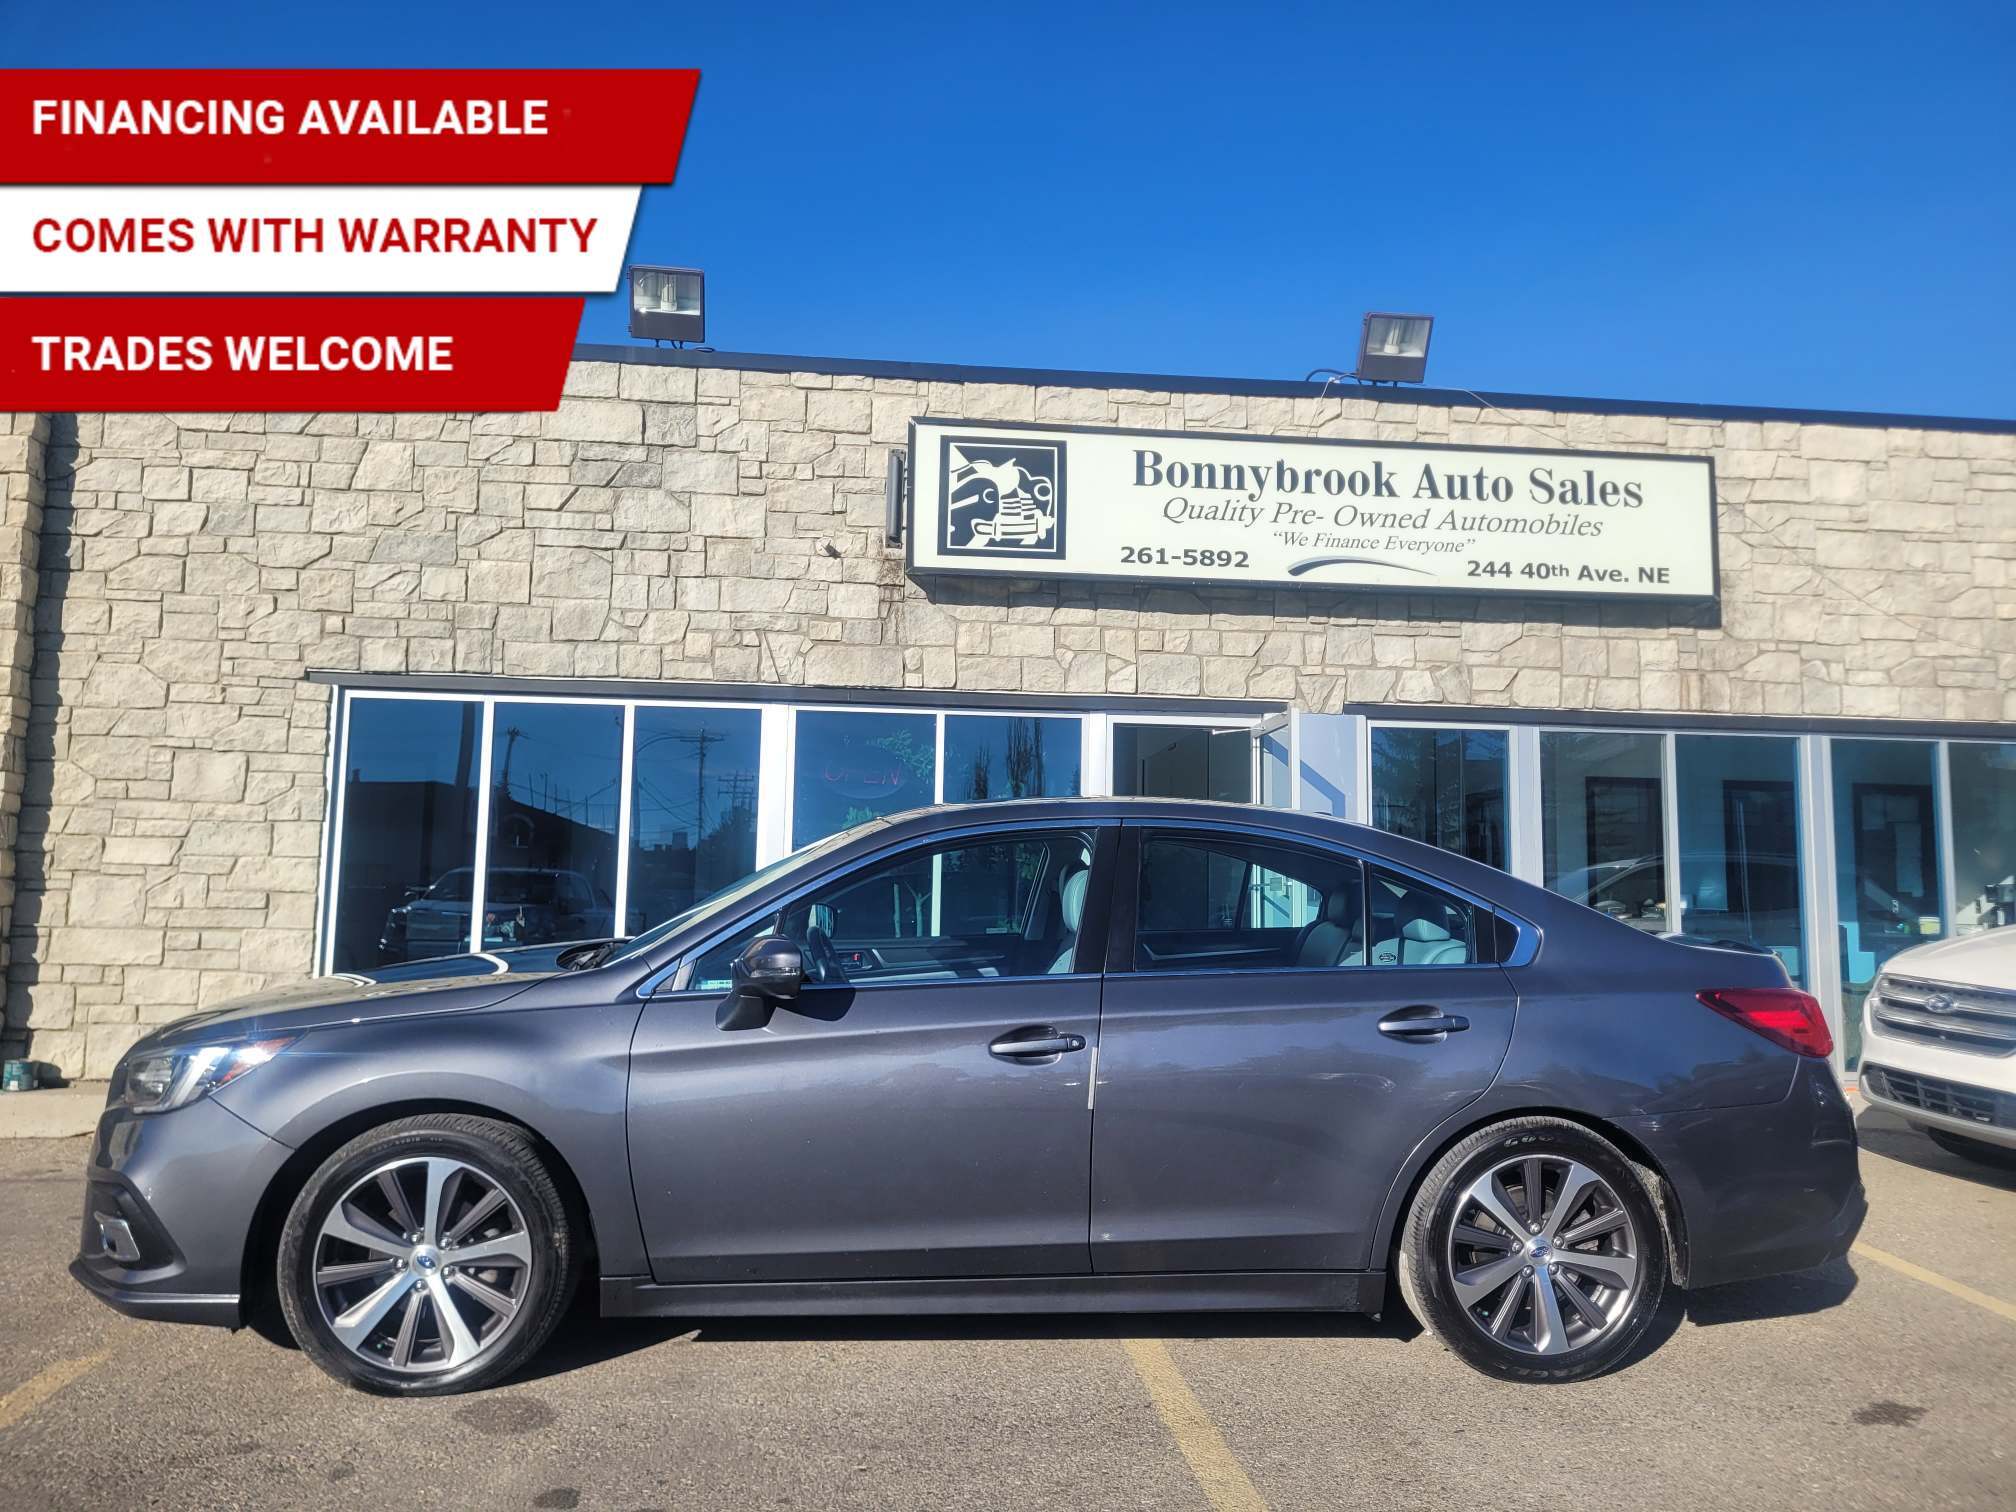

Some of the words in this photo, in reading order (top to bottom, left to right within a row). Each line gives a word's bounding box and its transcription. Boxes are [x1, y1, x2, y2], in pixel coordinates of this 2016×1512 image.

[1133, 449, 1400, 502] Bonnybrook
[1412, 463, 1514, 502] Auto
[1529, 467, 1643, 508] Sales
[1163, 496, 1264, 527] Quality
[1334, 504, 1431, 530] Owned
[1435, 509, 1603, 537] Automobiles
[1313, 532, 1380, 550] Finance
[1120, 546, 1250, 568] 261-5892
[1467, 560, 1512, 578] 244
[1577, 565, 1629, 583] Ave.
[1638, 567, 1670, 584] NE
